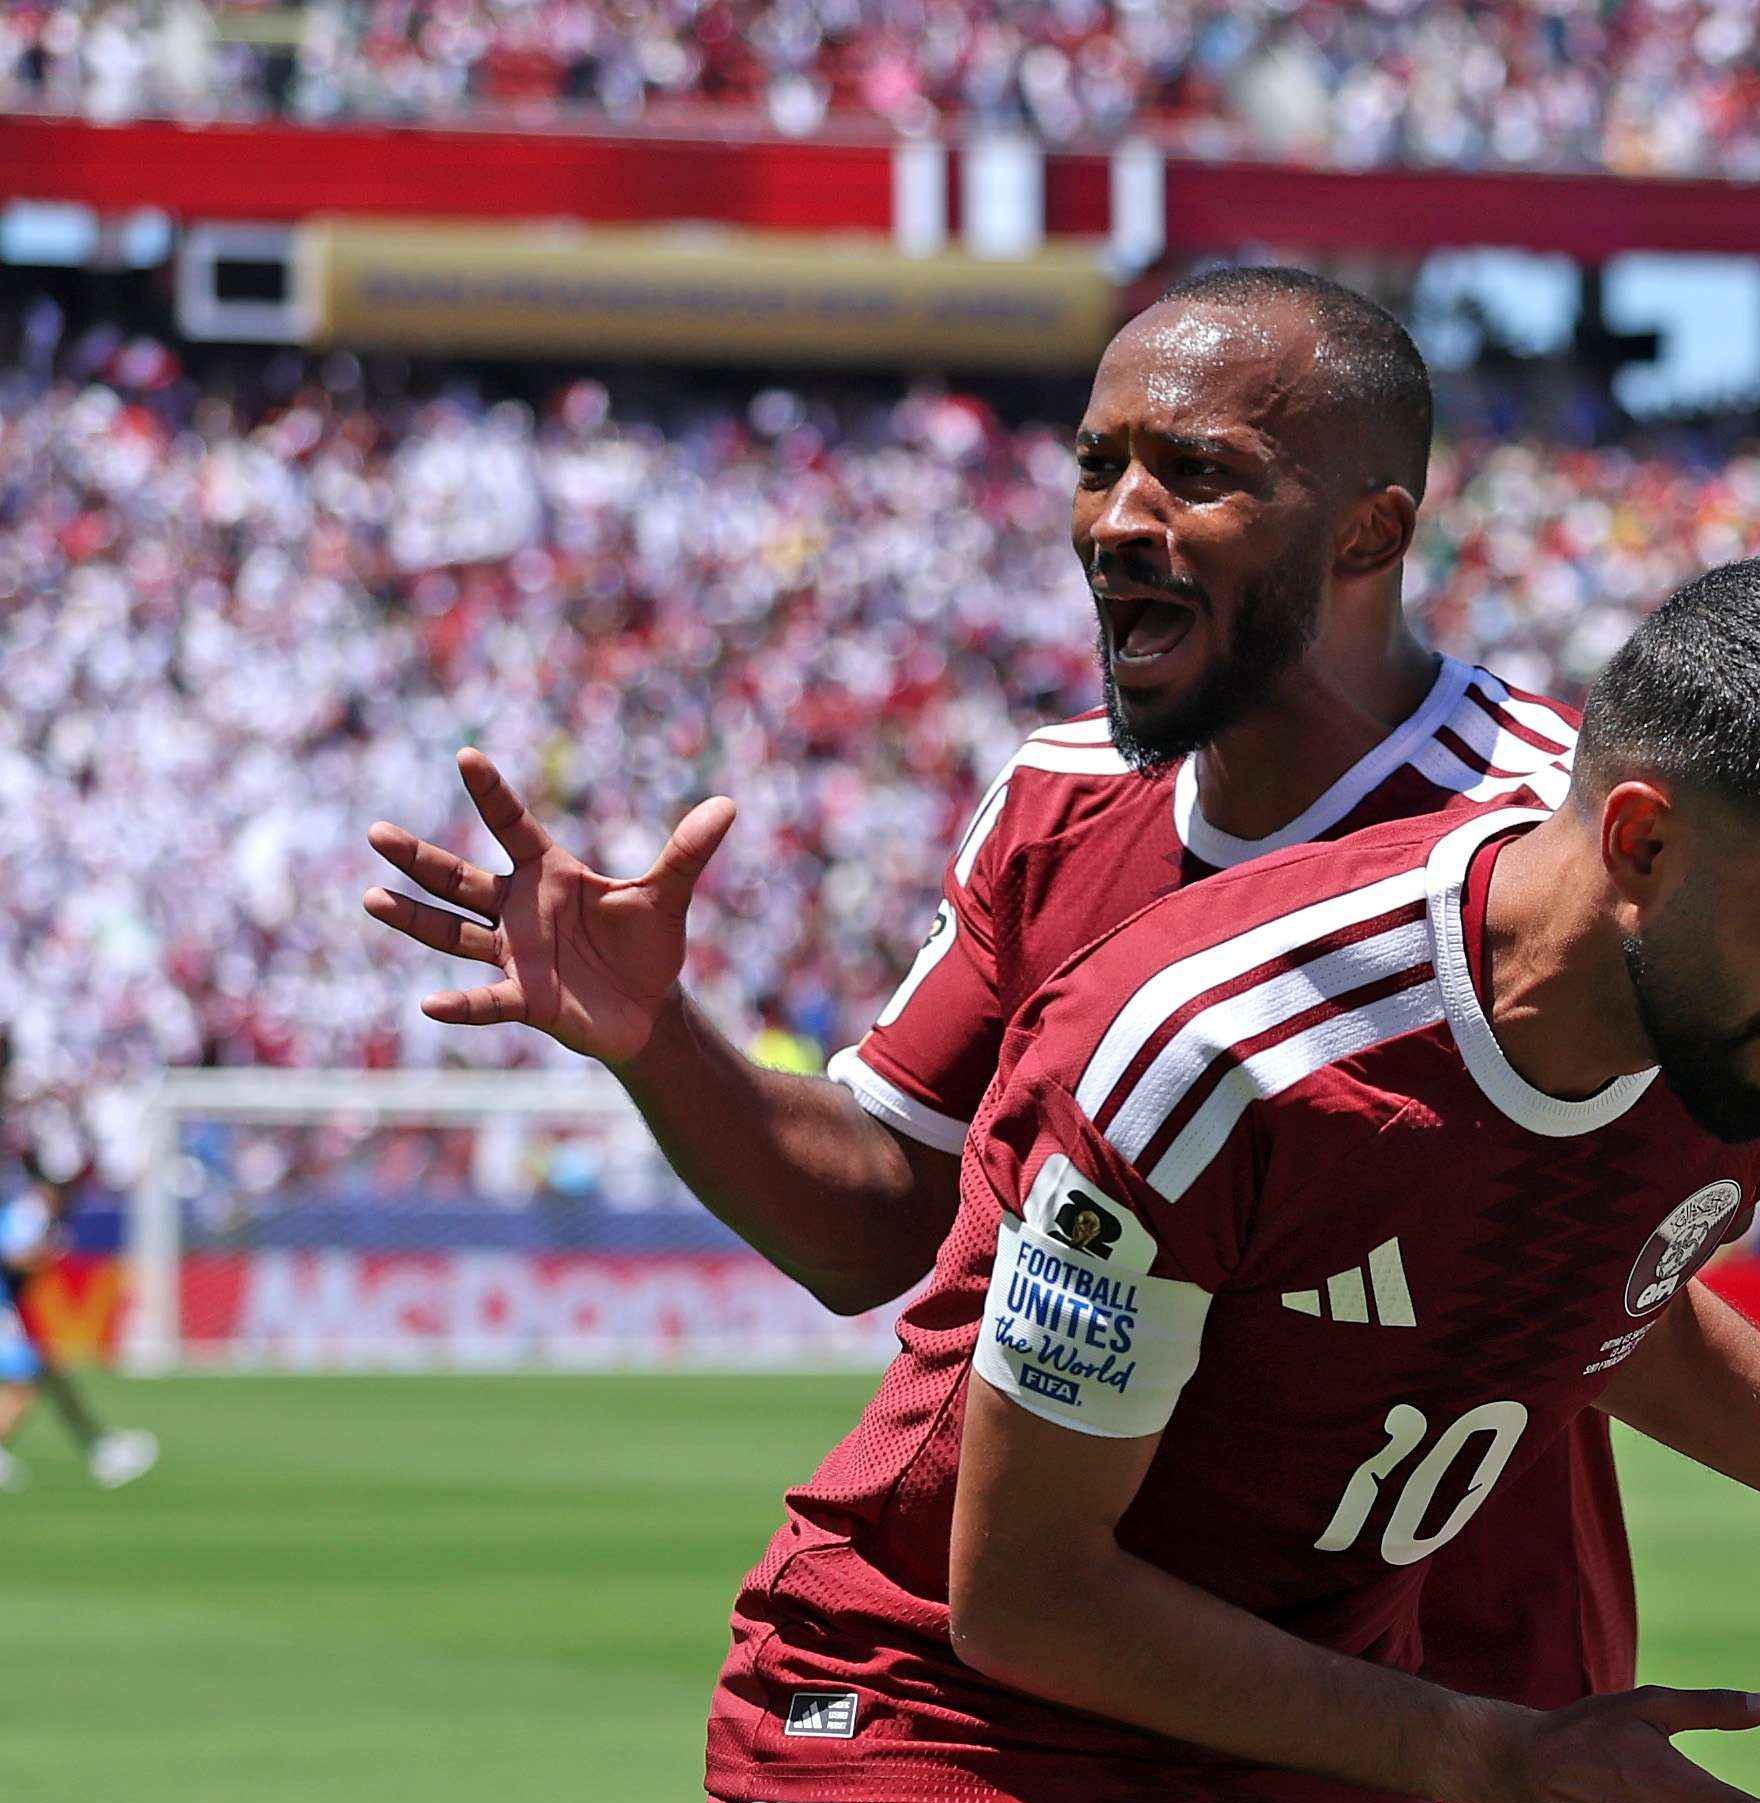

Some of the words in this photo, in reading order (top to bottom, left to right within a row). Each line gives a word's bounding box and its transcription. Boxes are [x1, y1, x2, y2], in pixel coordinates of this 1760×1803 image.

[1007, 1272, 1135, 1354] UNITES
[1016, 1241, 1138, 1315] FOOTBALL
[995, 1314, 1033, 1355] the
[1036, 1336, 1136, 1394] World
[1024, 1367, 1076, 1402] FIFA
[1314, 1401, 1528, 1566] 10
